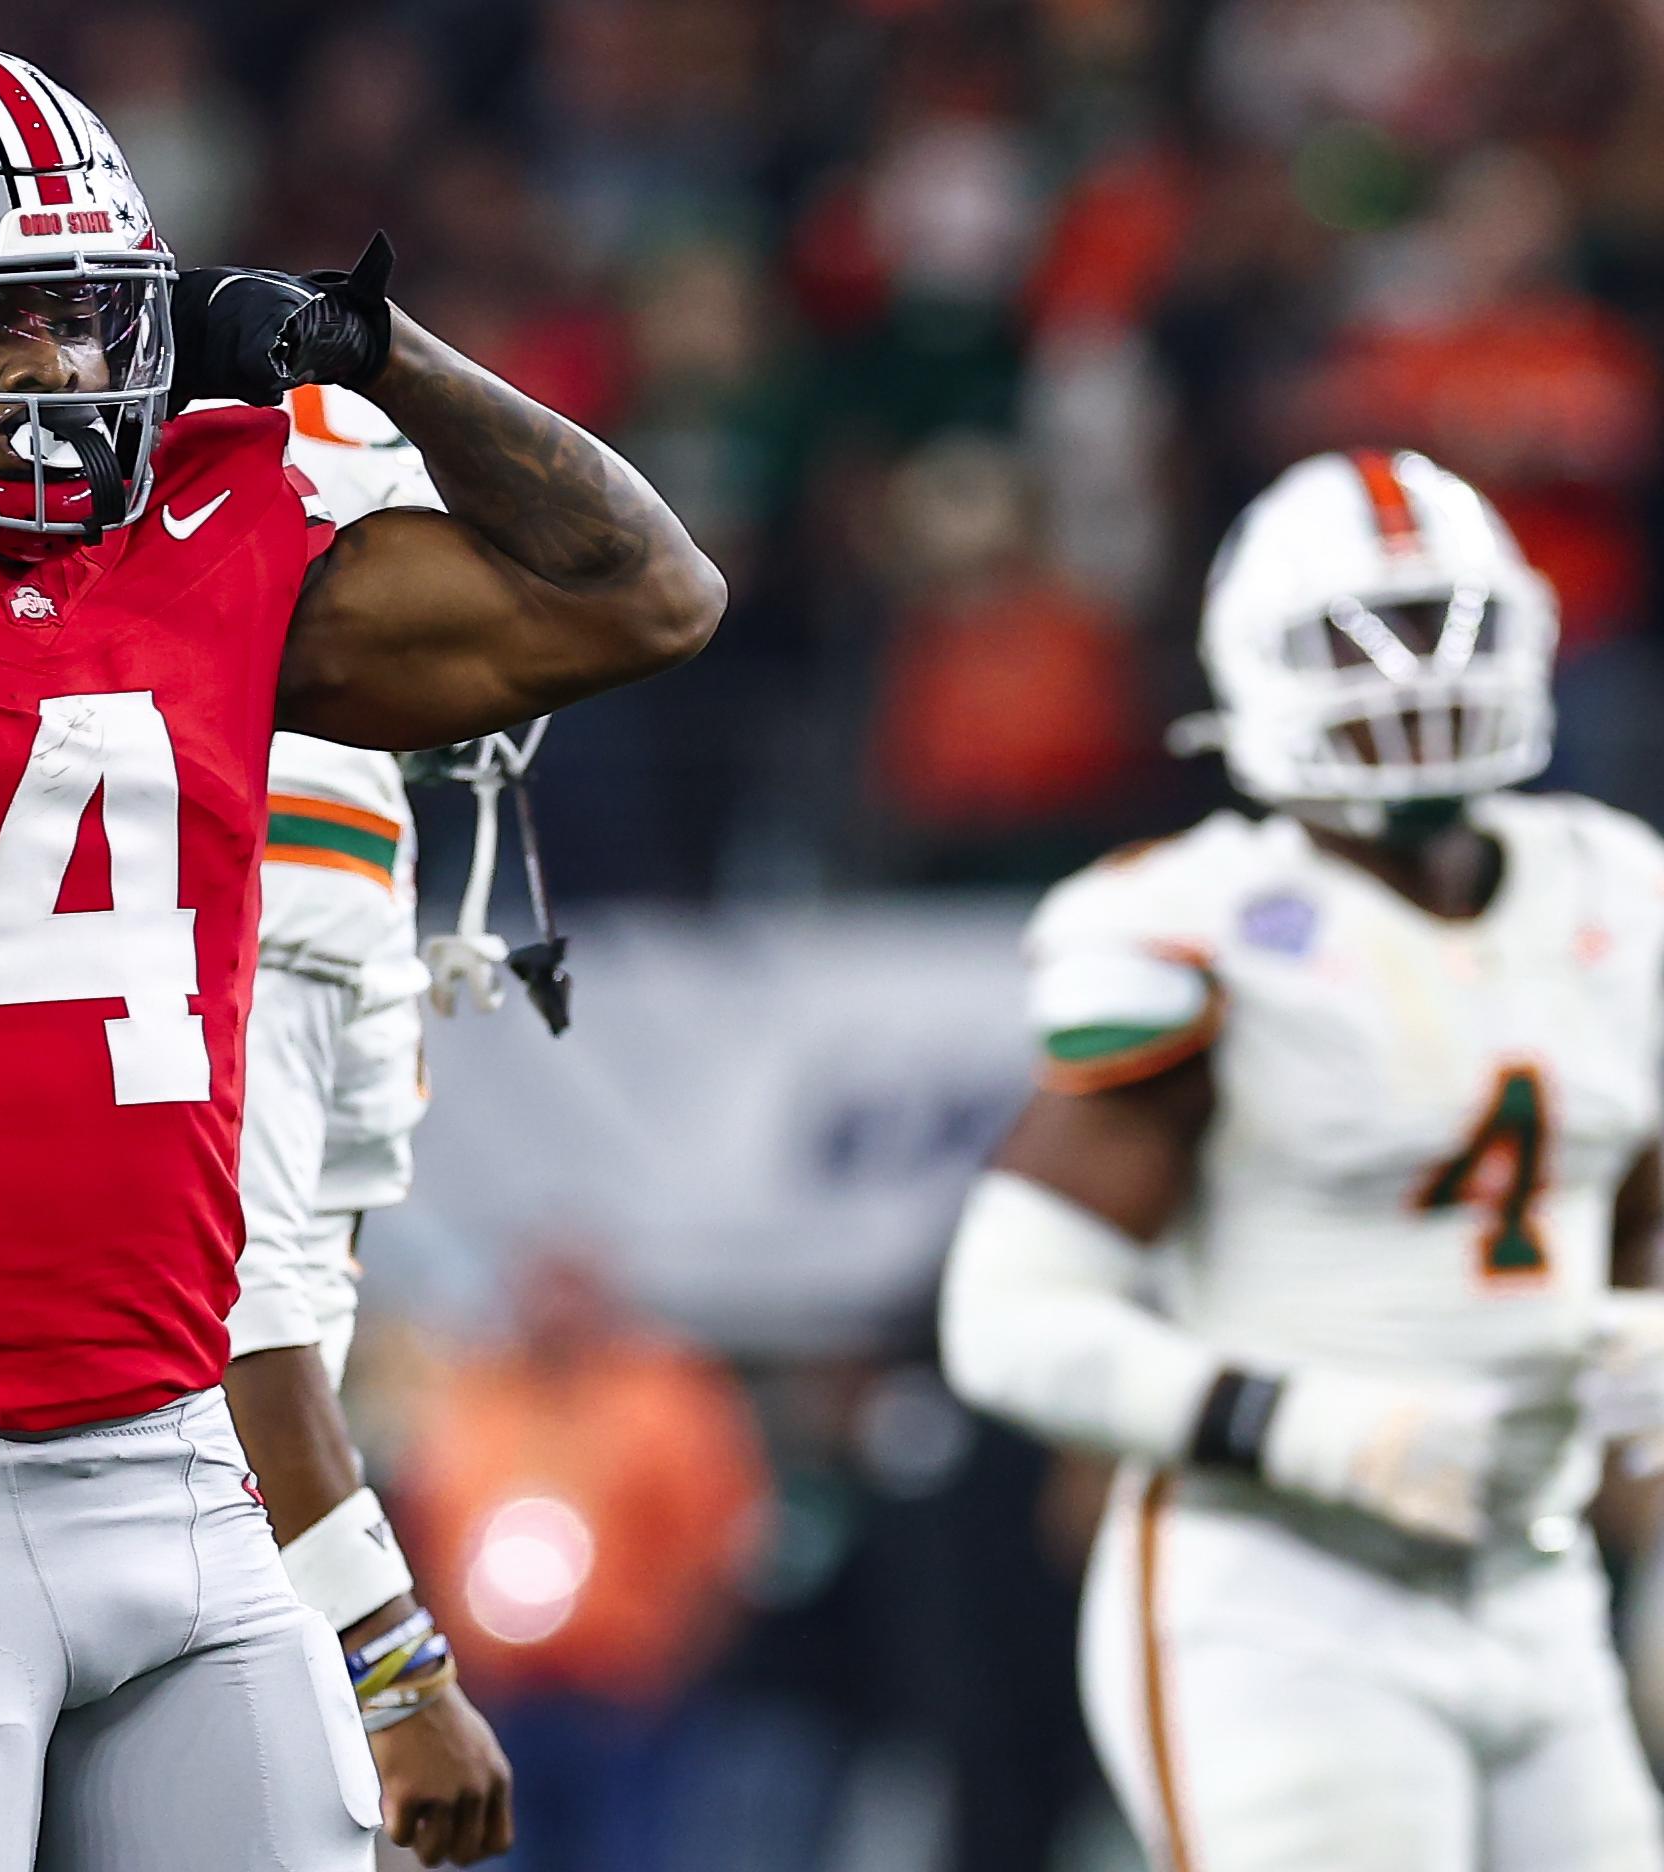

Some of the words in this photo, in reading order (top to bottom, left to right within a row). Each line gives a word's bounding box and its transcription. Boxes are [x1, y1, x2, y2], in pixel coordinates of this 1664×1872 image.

[19, 212, 63, 237] OHIO
[67, 210, 114, 234] STATE
[1413, 1062, 1549, 1280] 4
